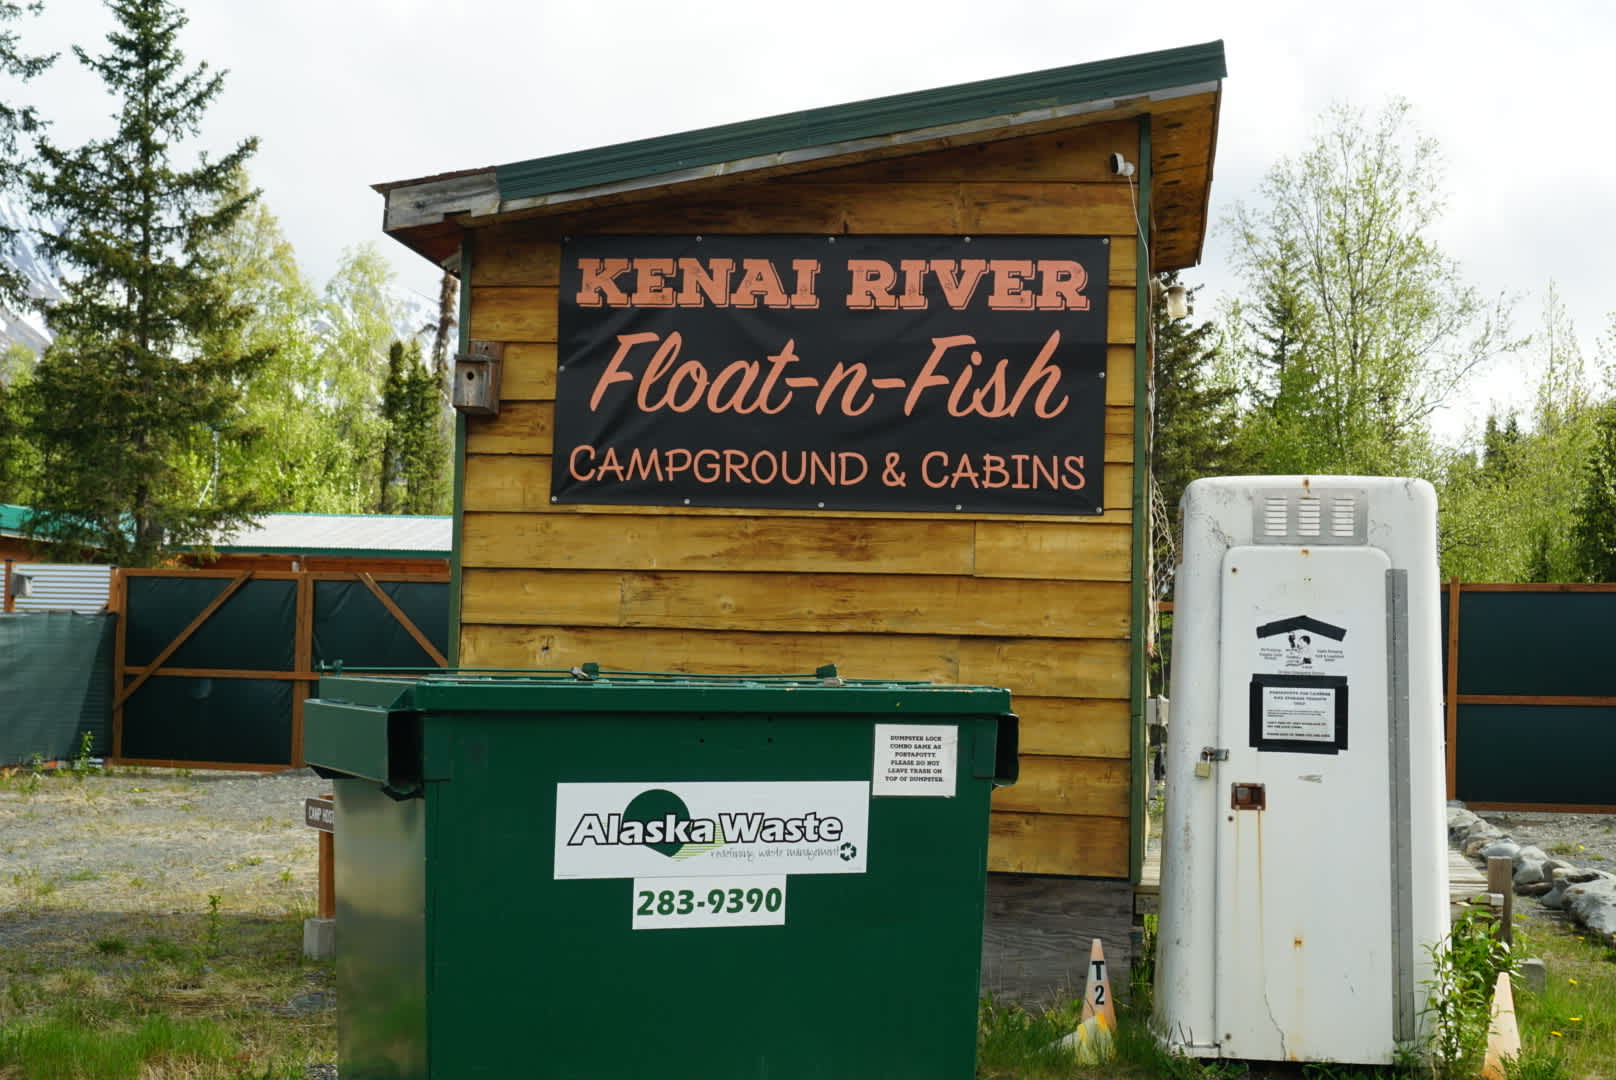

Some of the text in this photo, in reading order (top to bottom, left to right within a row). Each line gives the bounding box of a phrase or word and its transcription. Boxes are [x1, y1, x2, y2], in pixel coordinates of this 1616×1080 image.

[576, 258, 1090, 311] KENAI RIVER
[590, 329, 1069, 419] Float-n-Fish
[569, 445, 1086, 490] CAMPGROUND & CABINS
[567, 812, 843, 846] Alaska Waste
[636, 887, 782, 916] 283-9390
